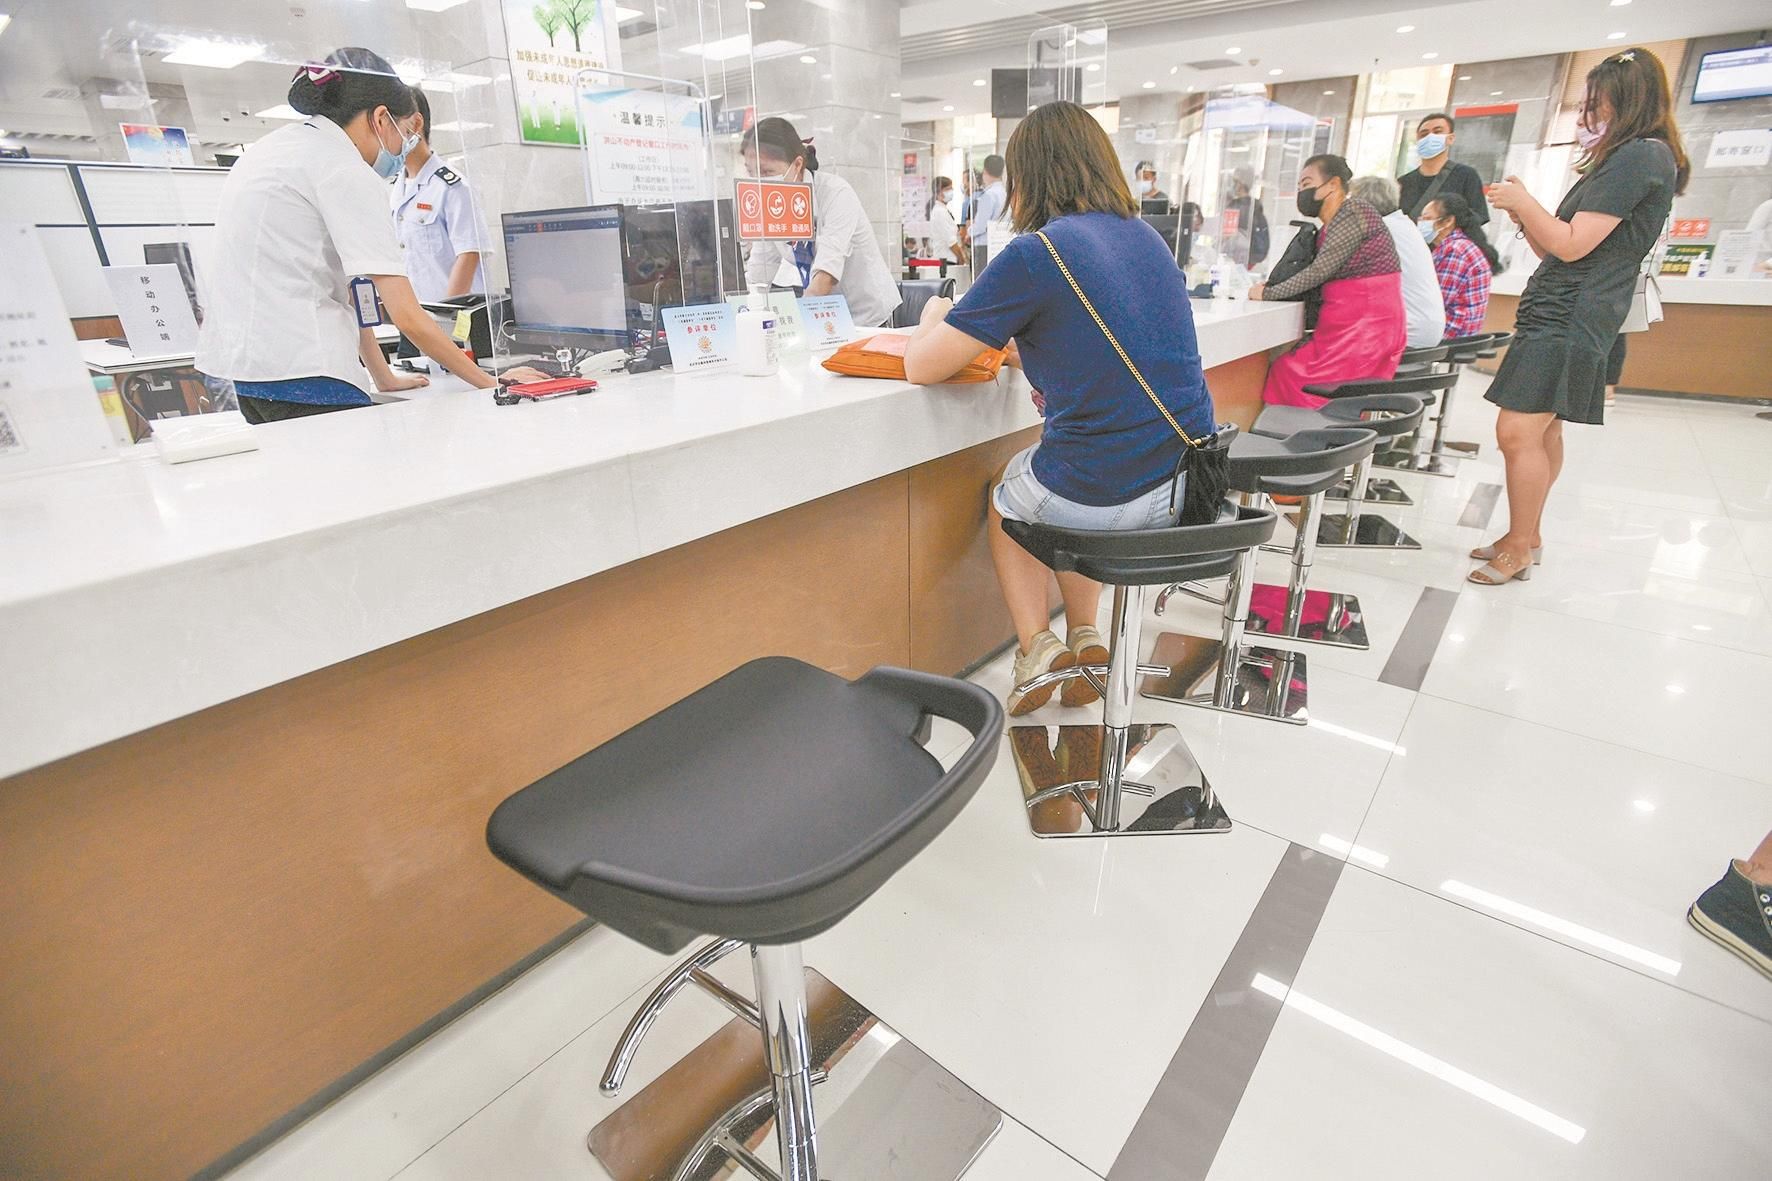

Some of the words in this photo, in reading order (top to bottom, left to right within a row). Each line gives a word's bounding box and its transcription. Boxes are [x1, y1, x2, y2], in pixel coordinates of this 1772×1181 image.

[620, 111, 666, 128] 温馨提示
[742, 223, 762, 233] 戴口罩
[768, 223, 788, 233] 勤洗手
[791, 223, 811, 233] 勤通风
[687, 323, 717, 334] 参评单位
